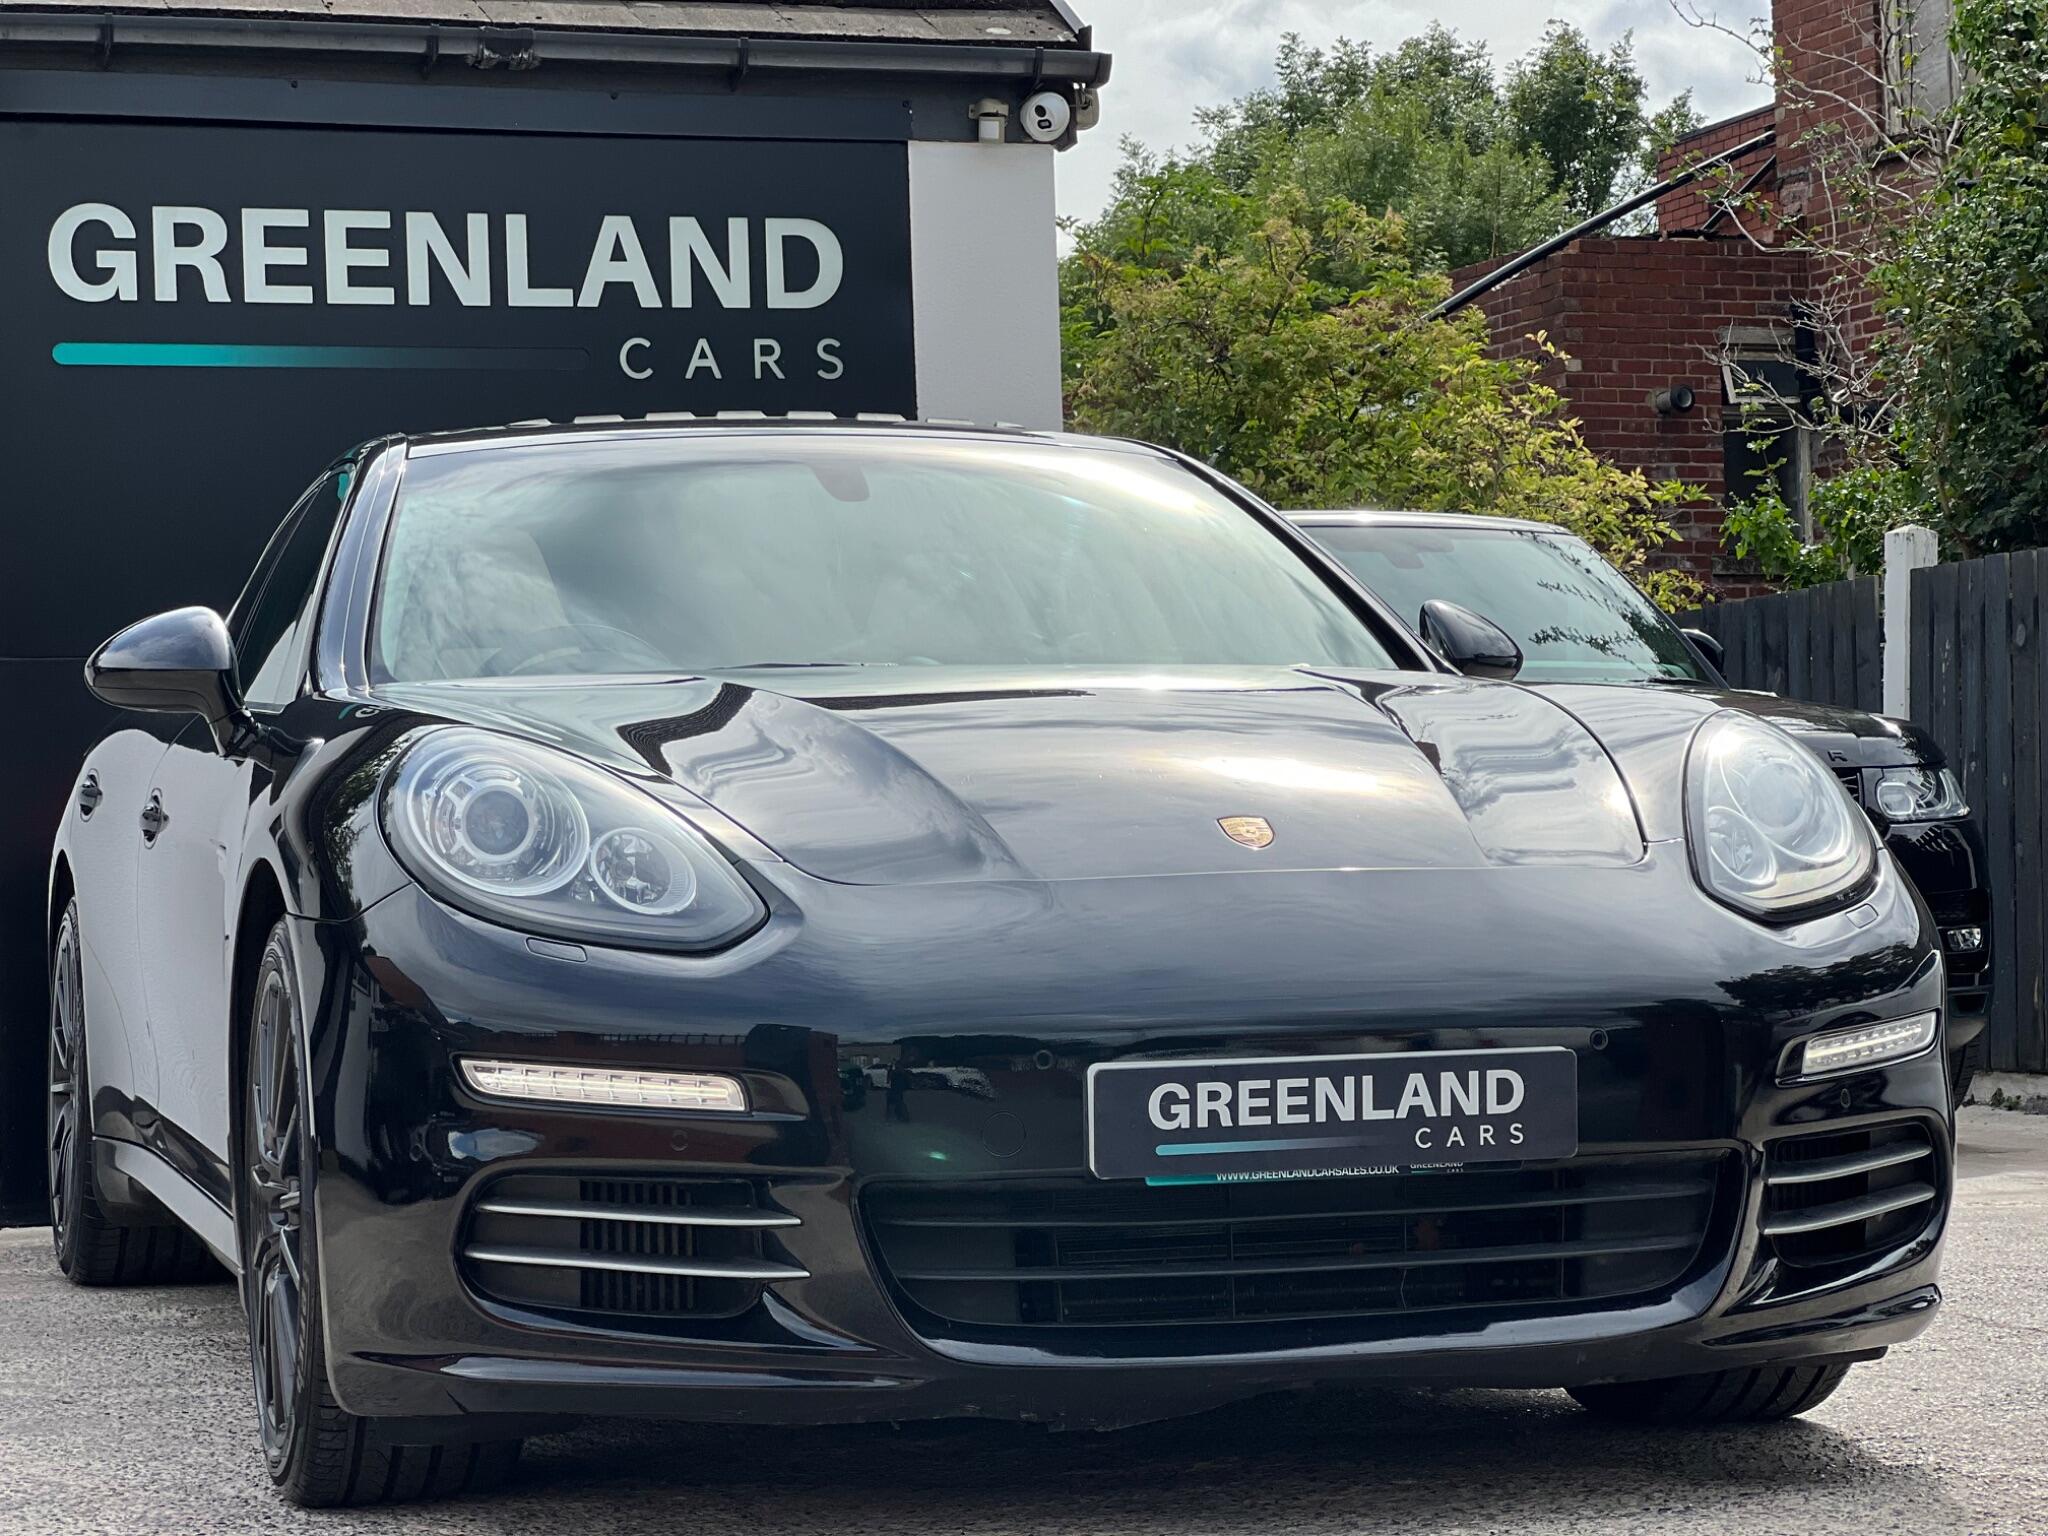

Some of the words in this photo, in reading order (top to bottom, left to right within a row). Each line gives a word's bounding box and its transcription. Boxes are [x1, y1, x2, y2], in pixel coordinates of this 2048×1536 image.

[47, 202, 844, 309] GREENLAND
[619, 337, 845, 381] CARS
[1148, 1069, 1525, 1132] GREENLAND
[1414, 1122, 1525, 1149] CARS
